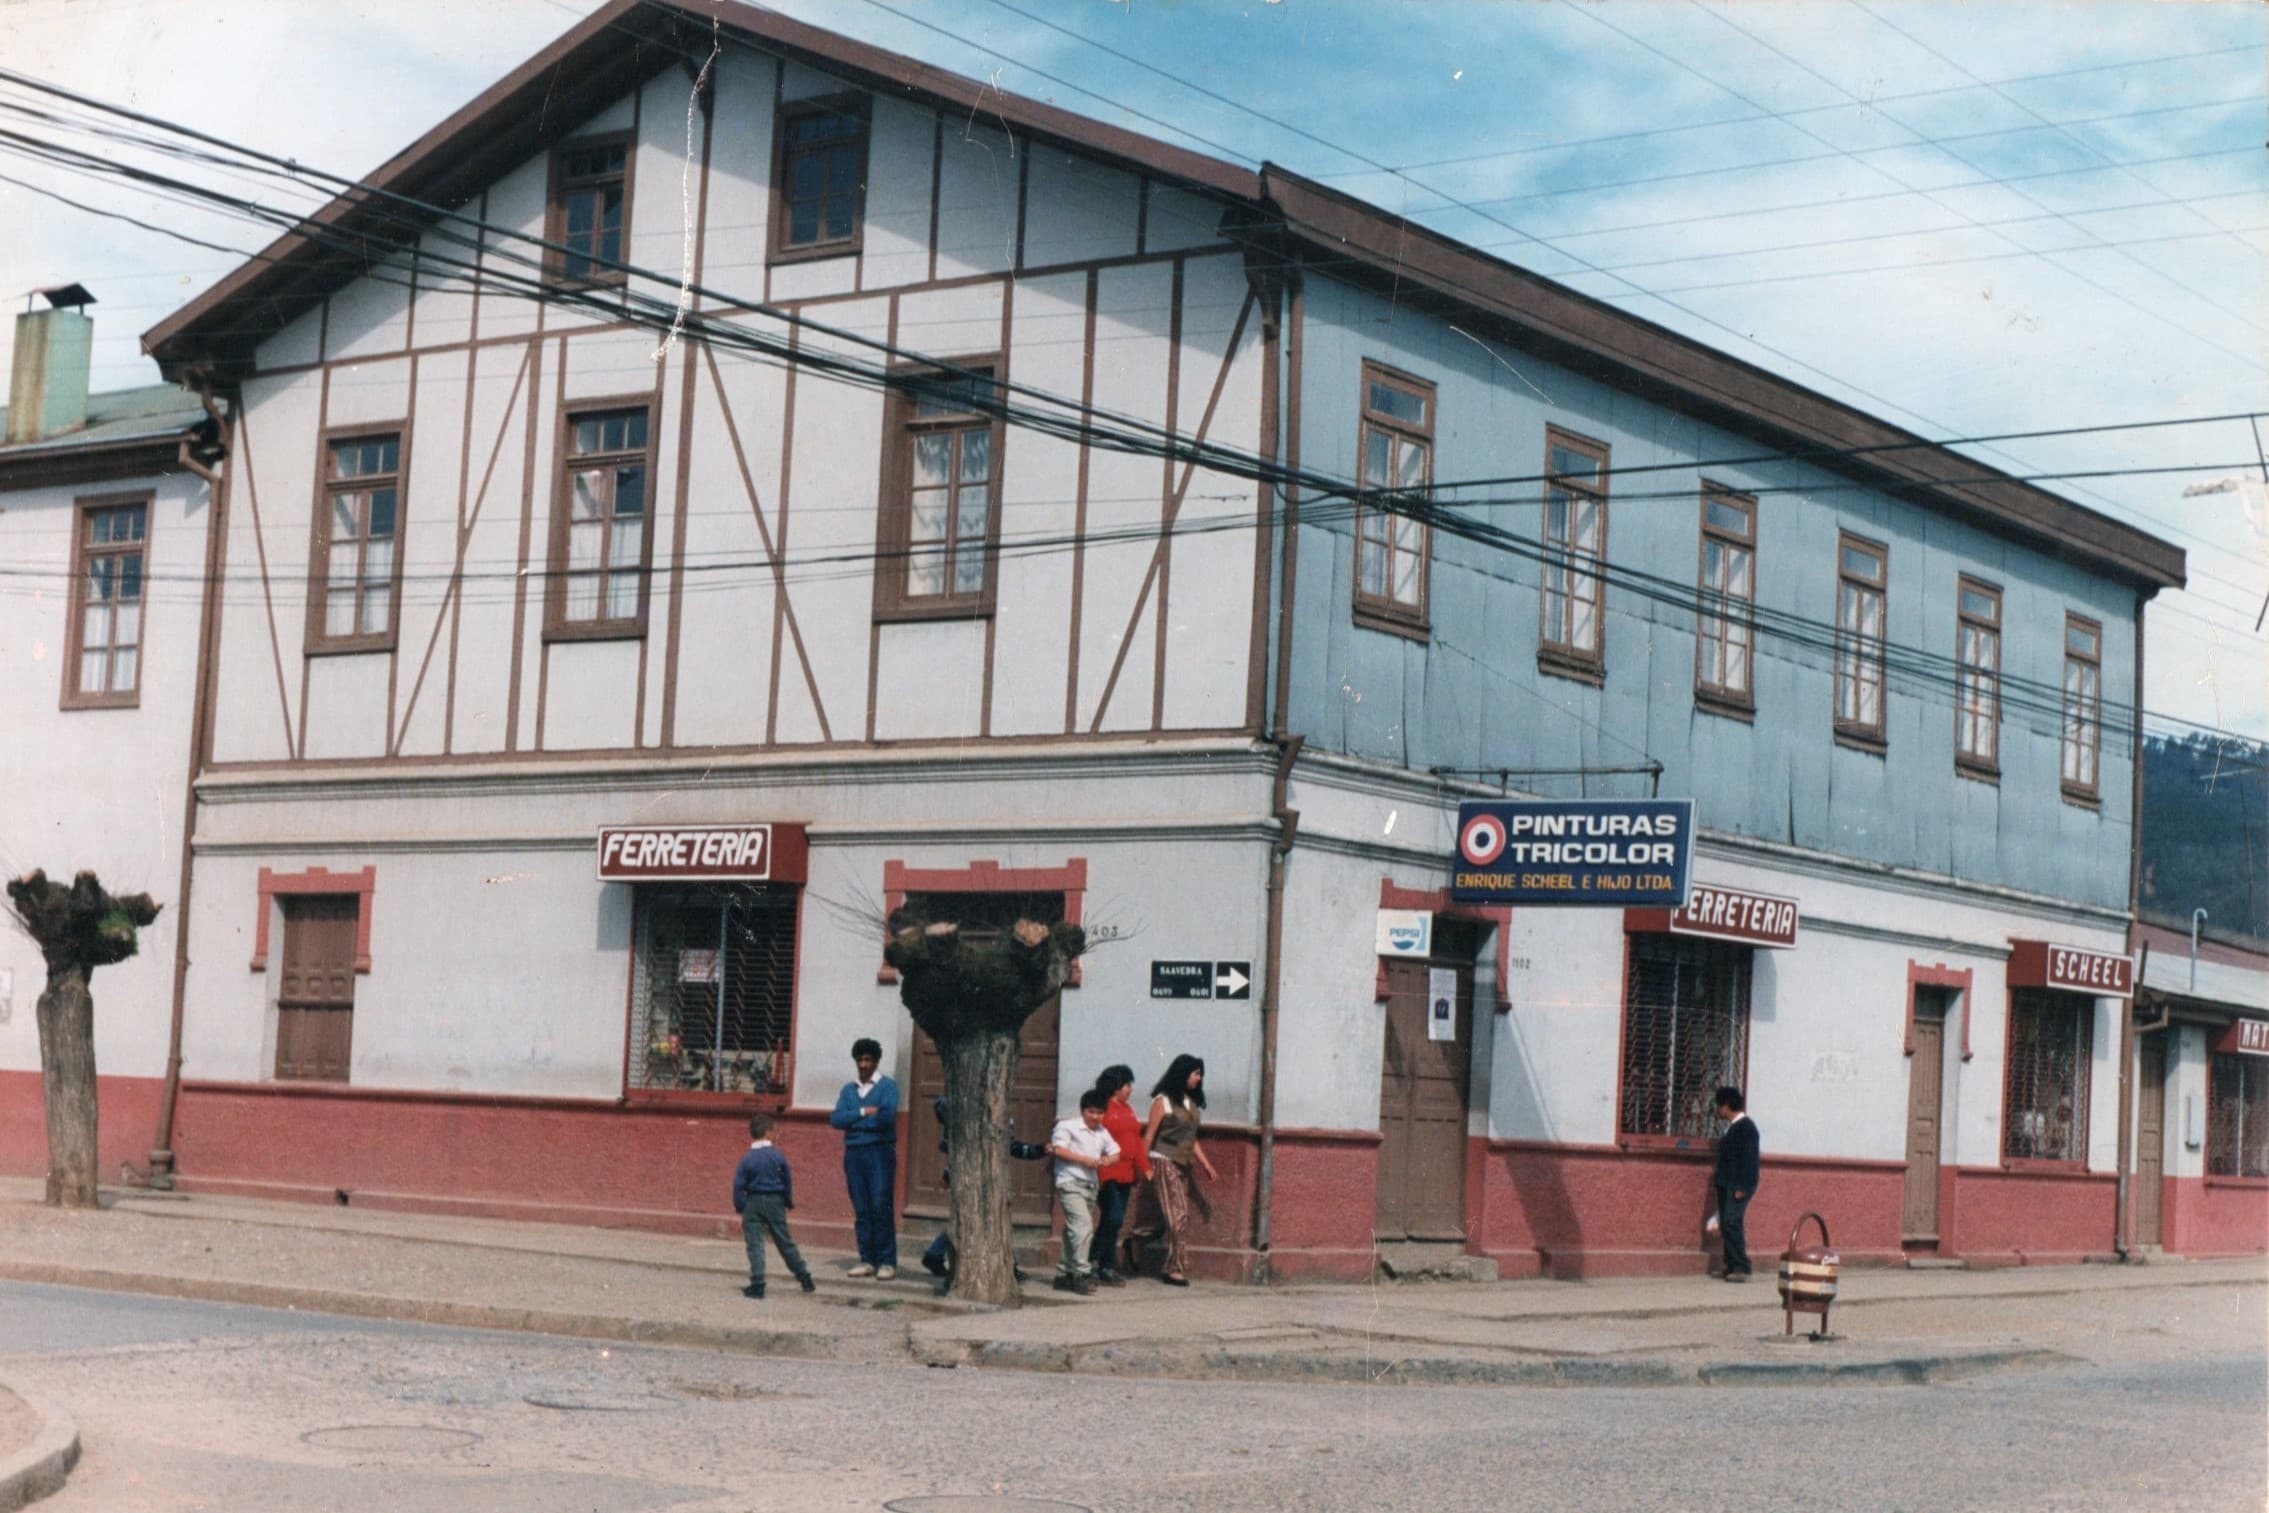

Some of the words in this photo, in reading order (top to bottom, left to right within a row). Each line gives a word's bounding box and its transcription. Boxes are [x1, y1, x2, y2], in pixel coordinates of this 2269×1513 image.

[1512, 815, 1677, 836] PINTURAS
[602, 831, 763, 867] FERRETERIA
[1512, 842, 1675, 865] TRICOLOR
[1456, 873, 1516, 890] ENRIQUE
[1521, 875, 1575, 889] SCHEEL
[1581, 875, 1591, 889] E
[1597, 875, 1631, 890] HIJO
[1674, 889, 1794, 936] ERRETERIA
[1389, 927, 1420, 938] PEPSI
[1160, 966, 1202, 976] SAAVEDRA
[1512, 957, 1531, 970] 1102
[2055, 952, 2122, 987] SCHEEL
